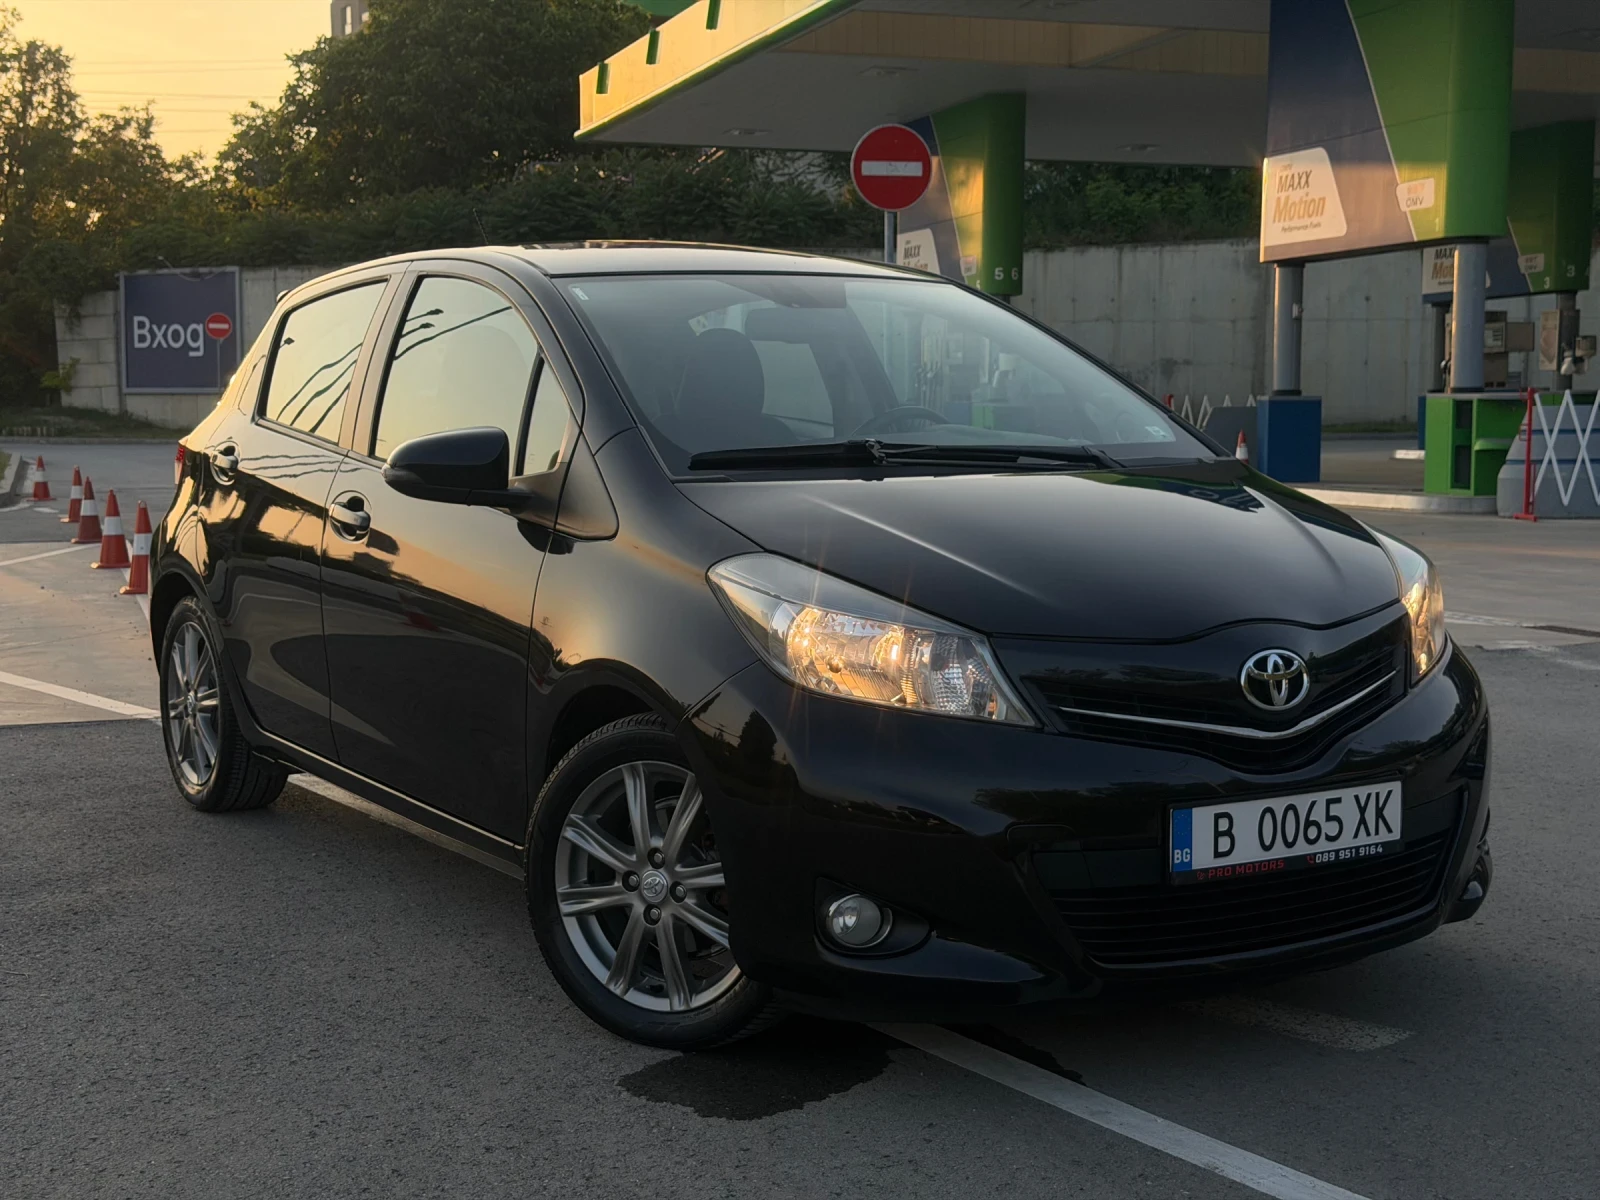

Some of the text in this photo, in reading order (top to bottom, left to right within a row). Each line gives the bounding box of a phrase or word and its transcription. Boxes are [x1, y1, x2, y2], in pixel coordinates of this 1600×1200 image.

[1277, 169, 1312, 194] MAXX
[1273, 192, 1326, 224] Motion
[1405, 196, 1424, 208] OMV
[995, 267, 1019, 280] 5 6
[1566, 265, 1576, 277] 3
[1543, 276, 1550, 289] 3
[1213, 789, 1394, 859] B 0065 XK
[1174, 848, 1191, 864] BG
[1315, 844, 1383, 863] 089 951 9164
[1208, 859, 1285, 879] PRO MOTORS
